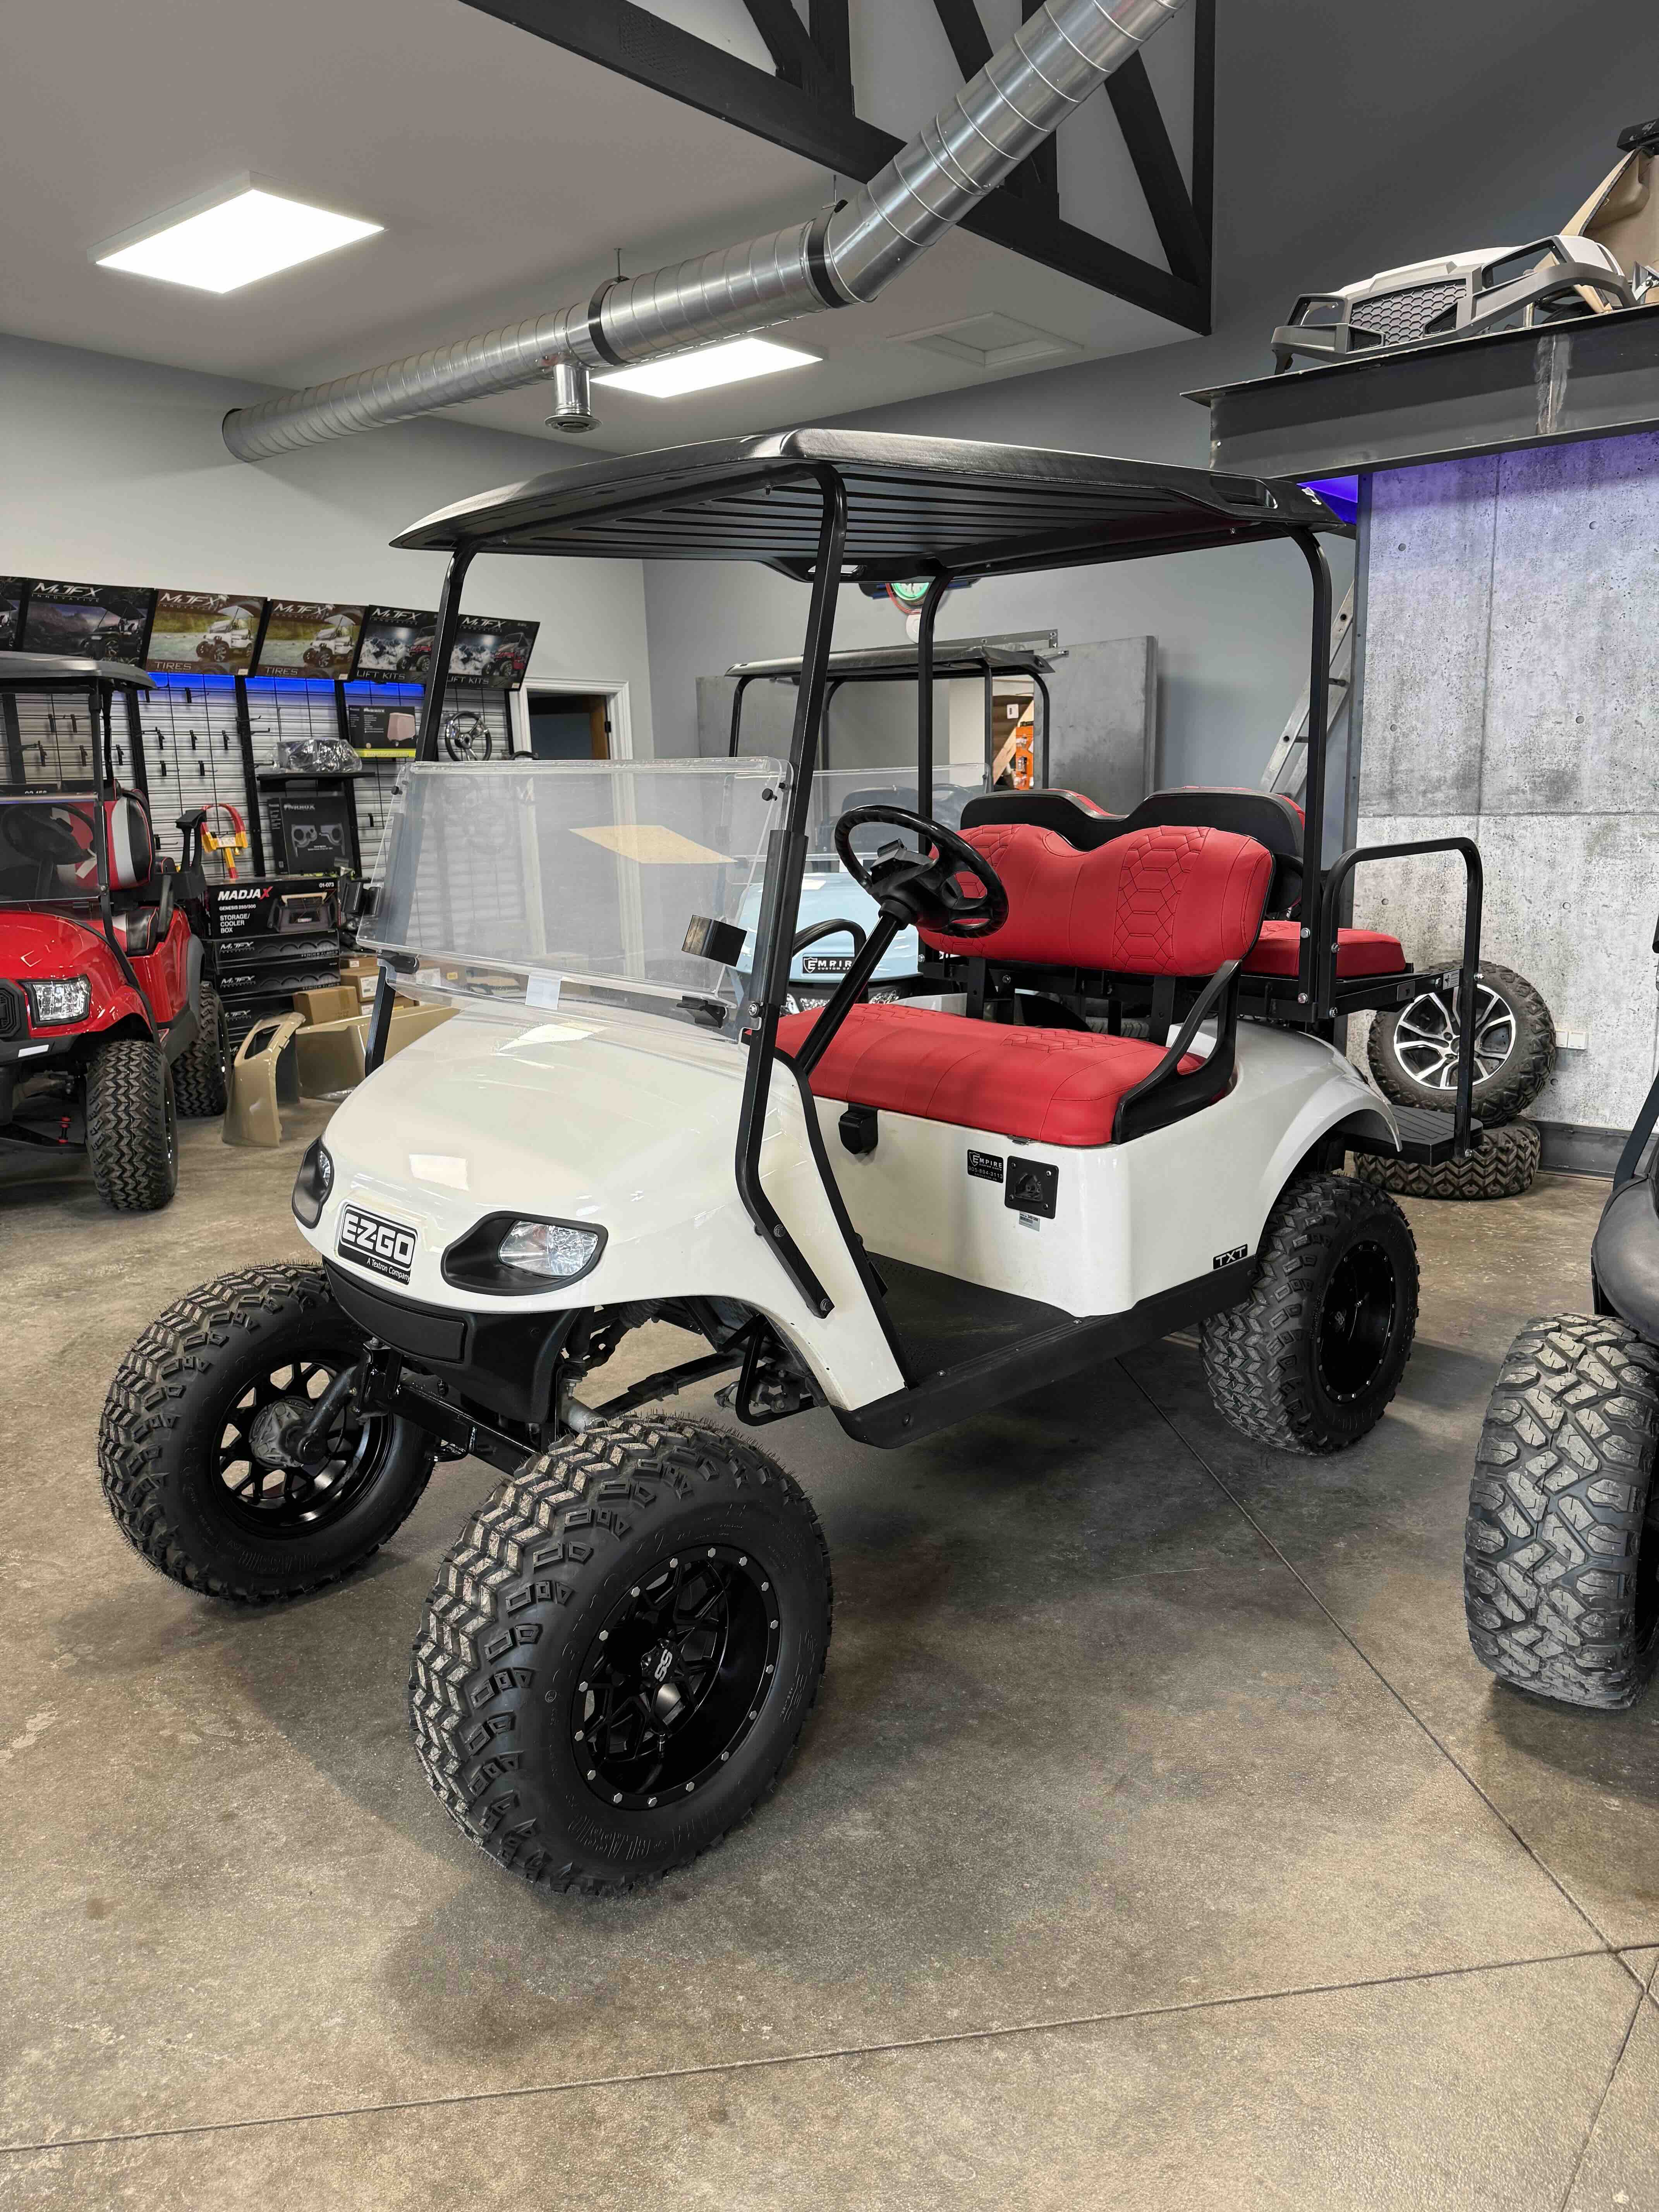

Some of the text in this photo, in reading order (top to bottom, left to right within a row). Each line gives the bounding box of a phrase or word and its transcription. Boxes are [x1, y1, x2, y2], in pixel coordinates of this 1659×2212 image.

[155, 661, 191, 670] TIRES
[265, 666, 298, 676] TIRES
[217, 886, 273, 901] MADJAX
[220, 913, 250, 921] STORAGE/
[807, 958, 853, 970] EMPIR
[973, 1154, 1002, 1168] EMPIRE
[1215, 1246, 1246, 1266] TXT
[371, 1259, 388, 1273] Textron
[388, 1266, 410, 1283] Company
